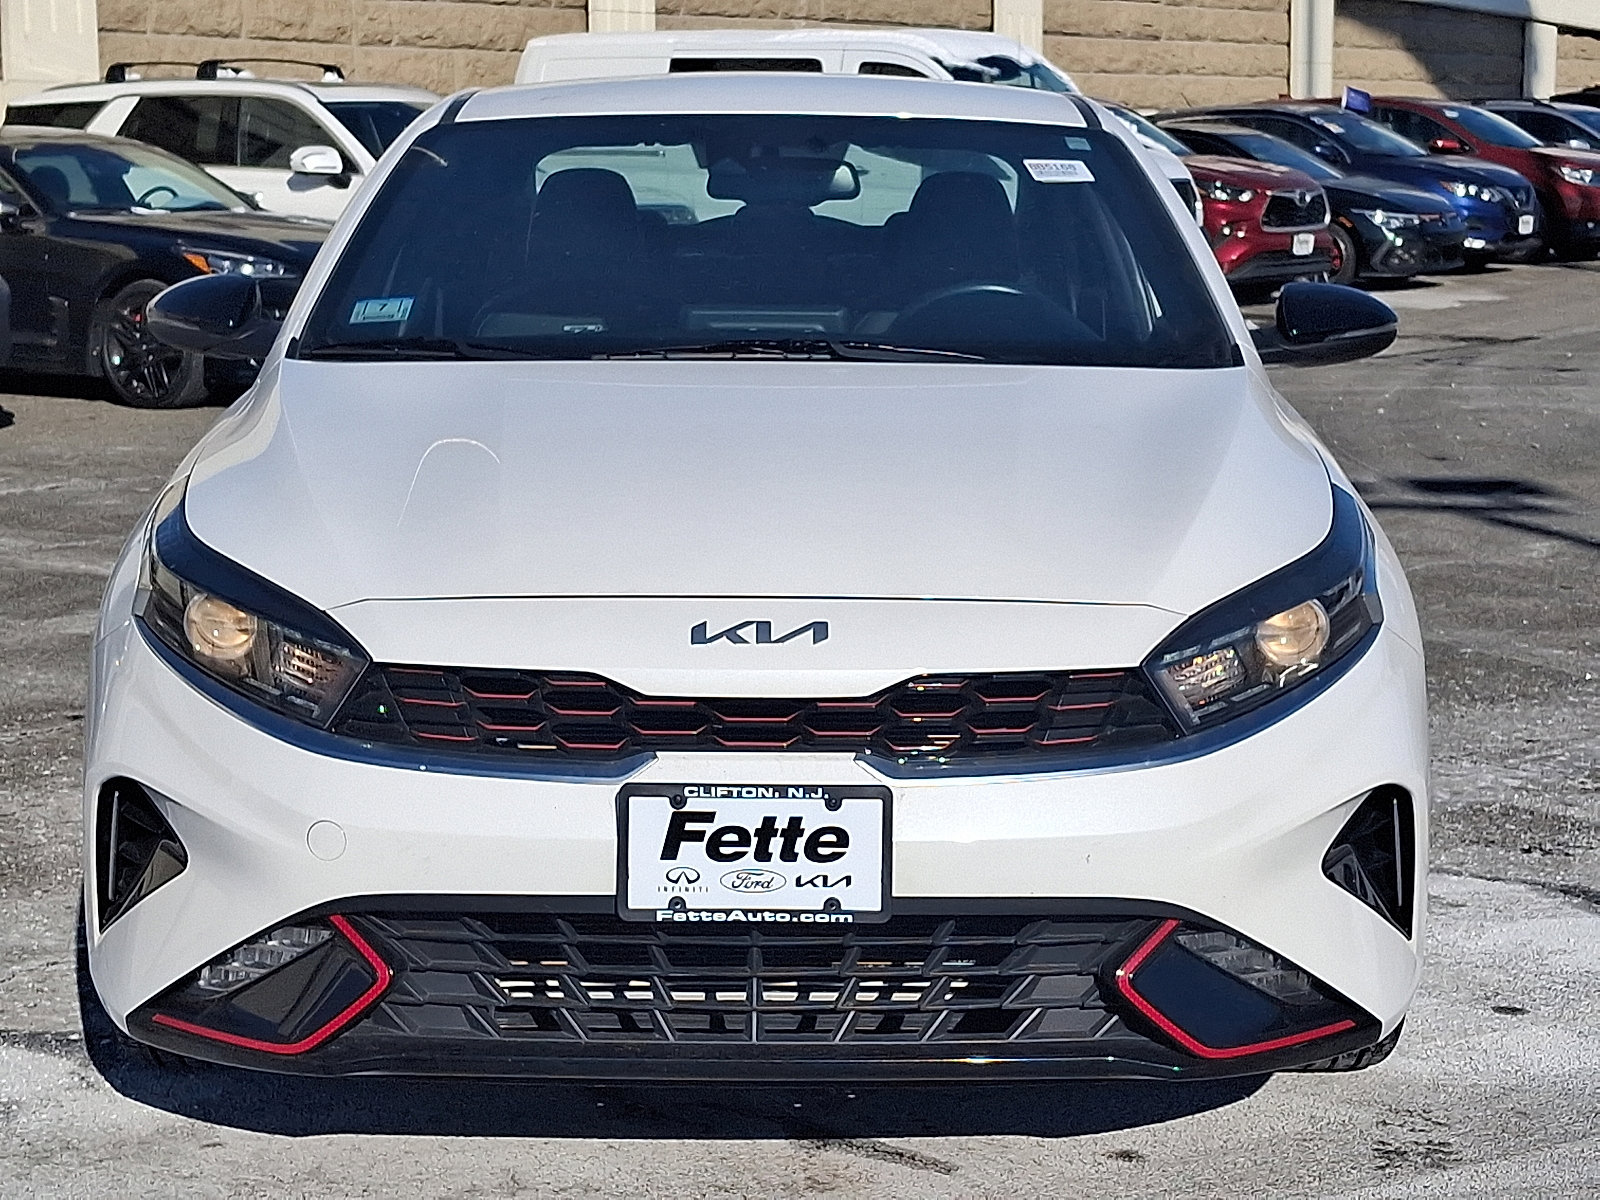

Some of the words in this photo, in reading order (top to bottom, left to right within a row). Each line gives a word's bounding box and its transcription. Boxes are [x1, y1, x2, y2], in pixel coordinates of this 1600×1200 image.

[690, 620, 828, 644] KIA
[788, 787, 829, 799] N.J.
[660, 811, 849, 863] Fette
[732, 872, 774, 889] Ford
[796, 874, 851, 888] KIA
[656, 910, 853, 923] FetteAuto.com
